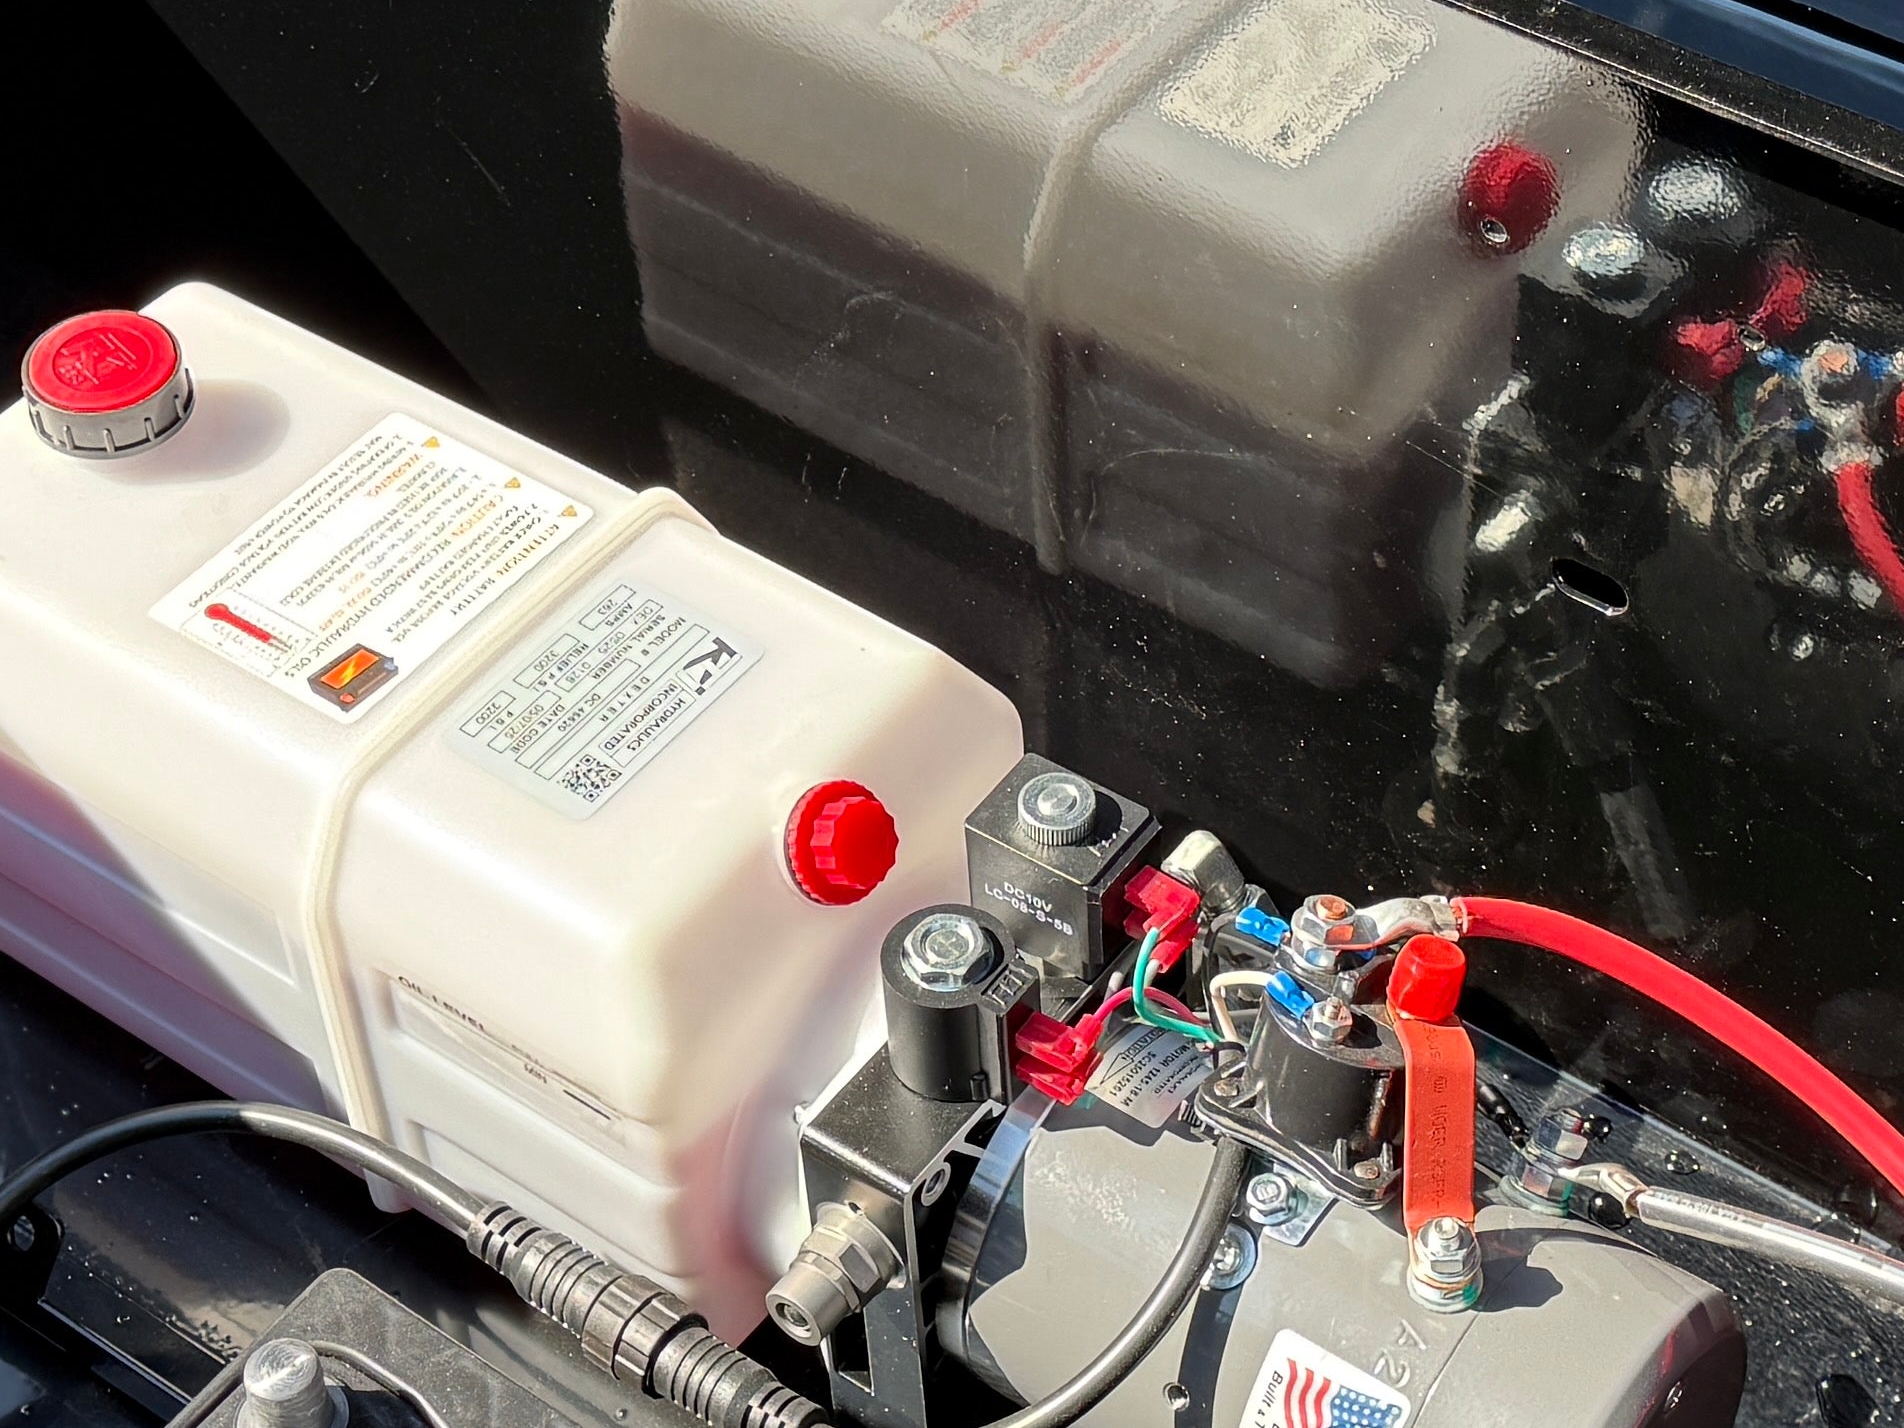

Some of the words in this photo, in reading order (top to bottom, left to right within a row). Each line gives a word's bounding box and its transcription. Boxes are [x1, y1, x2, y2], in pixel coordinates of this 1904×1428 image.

[632, 614, 665, 642] SERIAL
[648, 617, 685, 648] MODEL
[554, 643, 588, 671] RELIEF
[591, 644, 631, 679] NUMBER
[537, 704, 565, 727] DATE
[605, 683, 675, 750] INCORPORATED
[627, 698, 684, 751] HYDRAULICS
[509, 728, 539, 753] CODE
[1001, 882, 1053, 913] DC10V
[1261, 1370, 1284, 1407] Built
[1257, 1408, 1266, 1416] &
